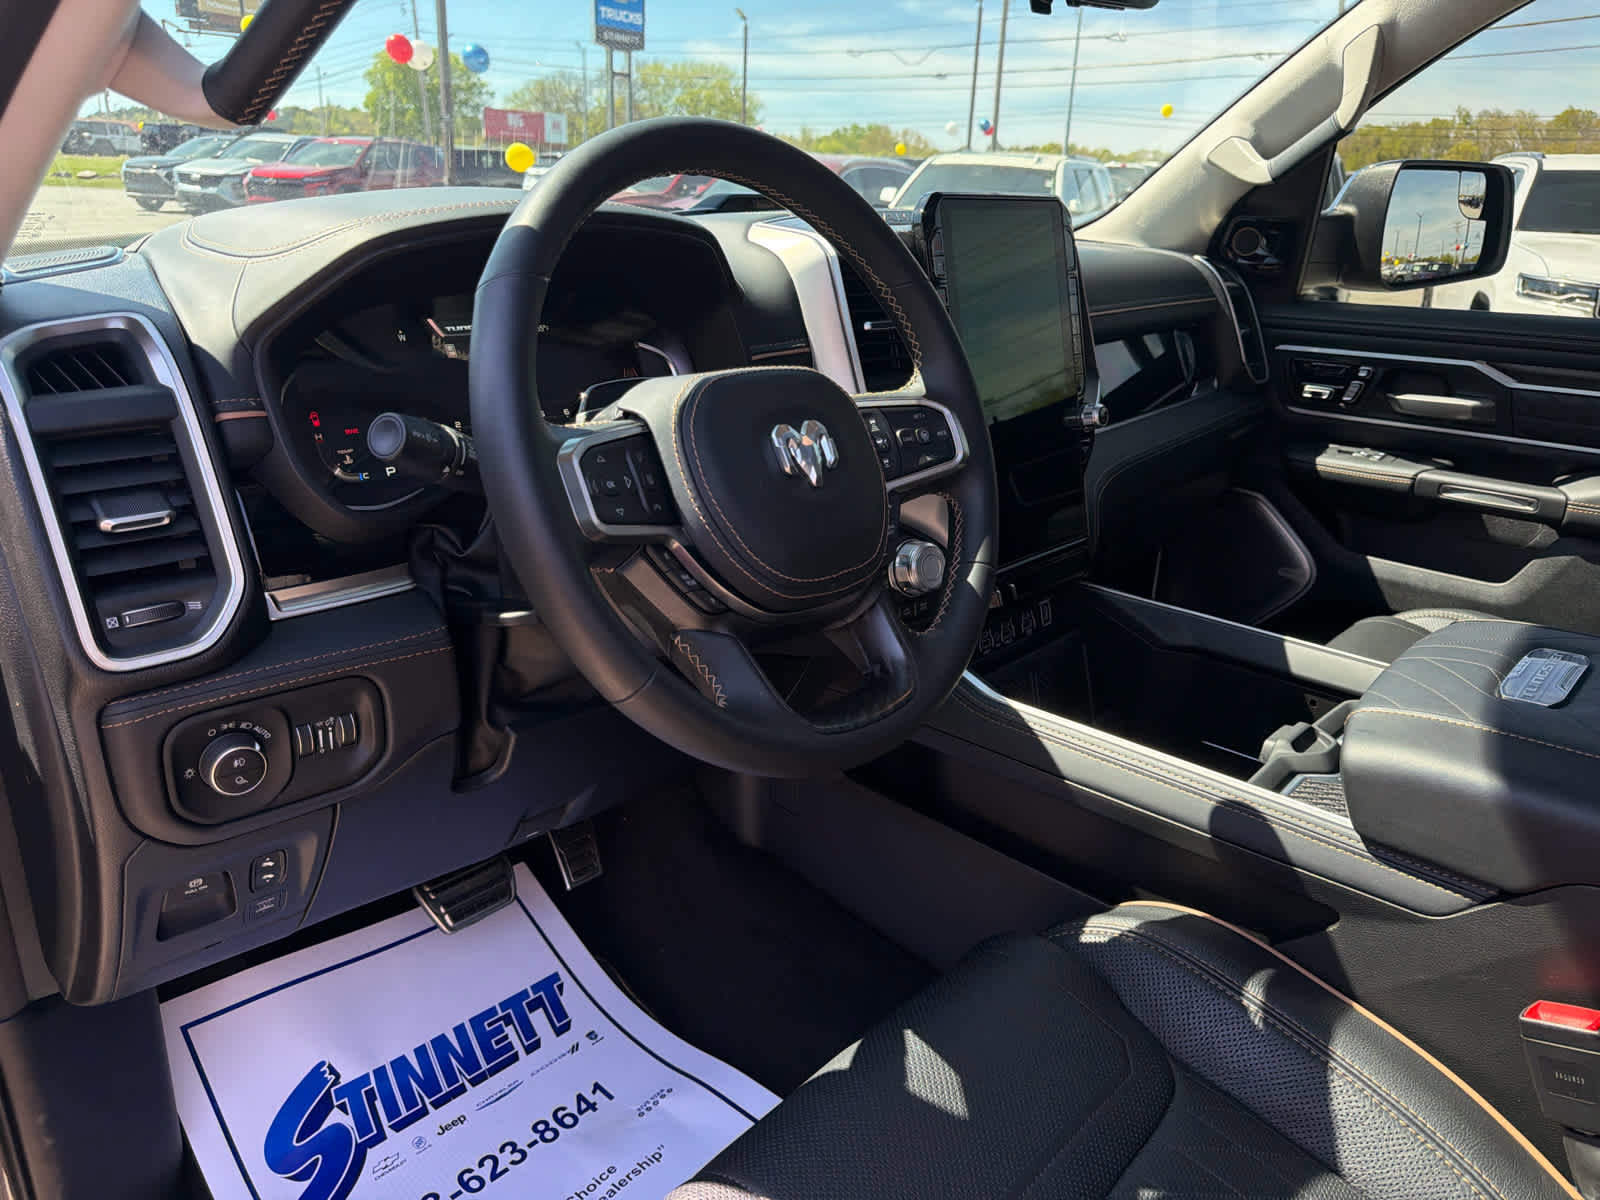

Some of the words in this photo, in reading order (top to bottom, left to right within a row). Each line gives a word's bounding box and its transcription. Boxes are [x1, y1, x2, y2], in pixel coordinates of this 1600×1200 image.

[600, 6, 642, 25] TRUCKS
[455, 421, 461, 429] 2
[386, 466, 396, 477] P
[253, 726, 271, 740] AUTO
[263, 971, 572, 1200] STINNETT
[437, 1114, 467, 1136] Jeep
